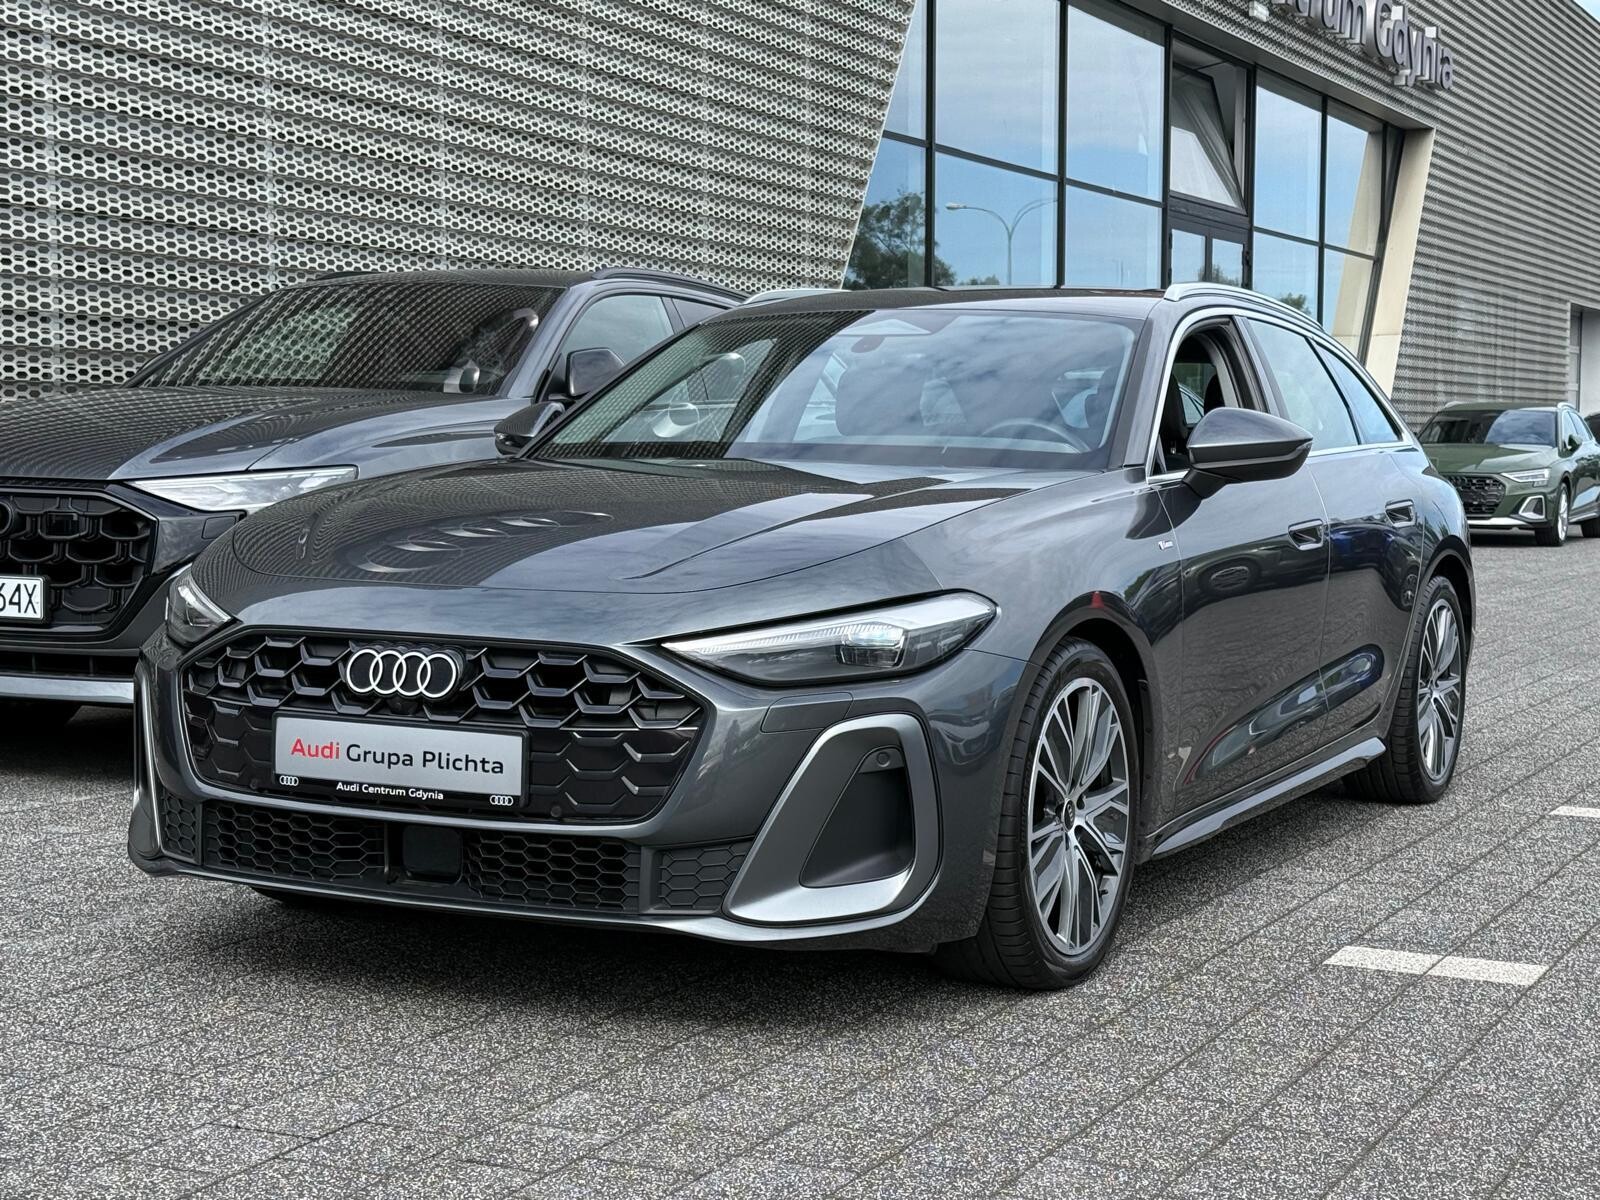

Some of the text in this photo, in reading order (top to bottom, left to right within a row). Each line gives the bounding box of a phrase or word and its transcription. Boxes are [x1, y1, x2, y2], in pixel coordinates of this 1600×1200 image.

[1374, 0, 1454, 89] Gdynia
[291, 738, 504, 775] Audi Grupa Plichta
[336, 782, 444, 800] Audi Centrum Gdynia
